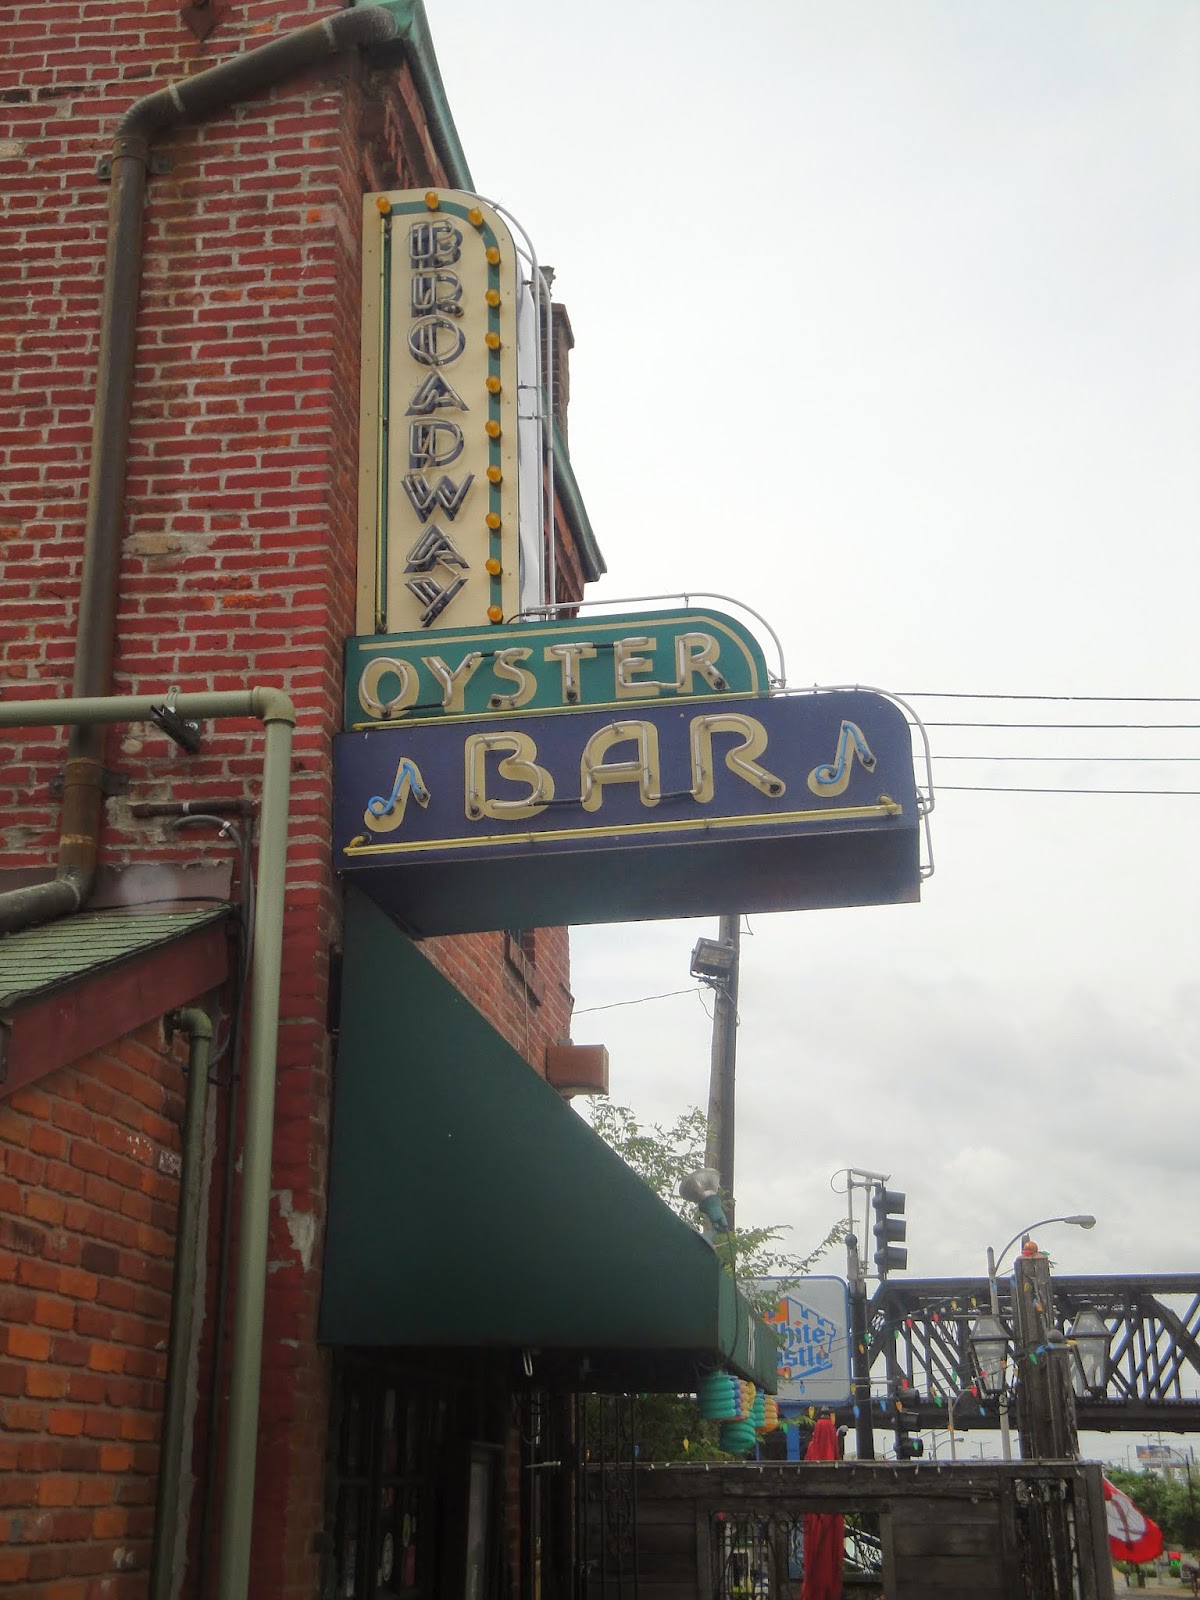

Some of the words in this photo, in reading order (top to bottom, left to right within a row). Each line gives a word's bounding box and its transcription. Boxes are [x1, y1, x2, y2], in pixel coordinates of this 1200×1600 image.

[401, 218, 474, 627] BROADWAY
[358, 632, 729, 718] OYSTER
[463, 714, 786, 821] BAR
[776, 1322, 826, 1347] hite
[776, 1344, 830, 1368] stle
